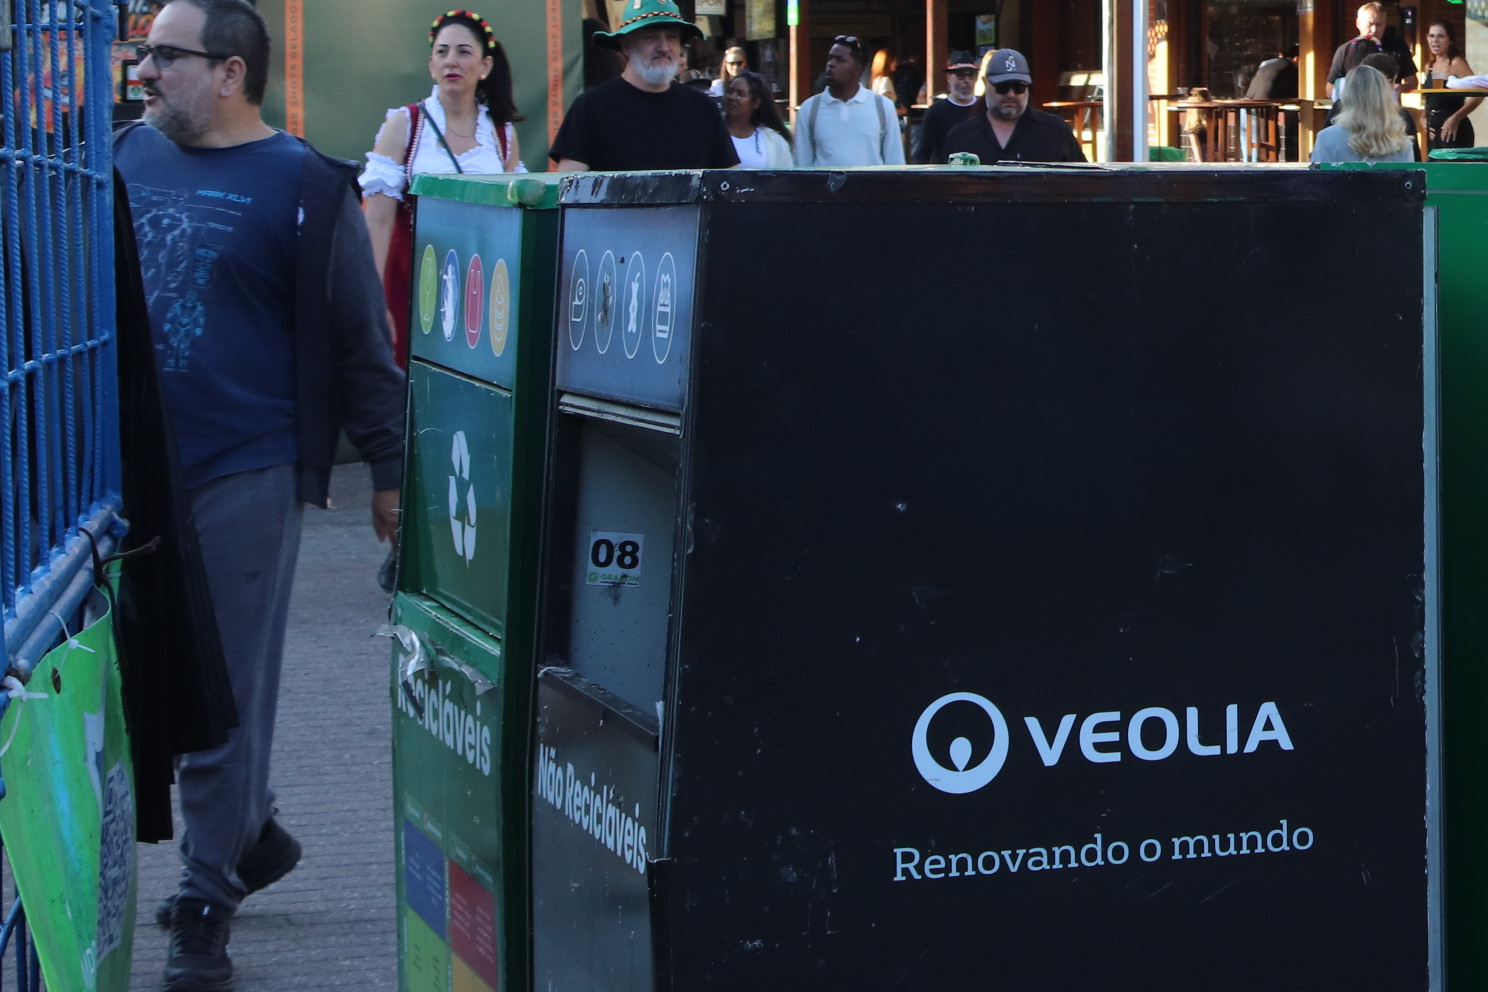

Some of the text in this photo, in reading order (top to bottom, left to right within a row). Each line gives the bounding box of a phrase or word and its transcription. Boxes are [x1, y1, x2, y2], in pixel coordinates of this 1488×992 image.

[591, 538, 640, 570] 08
[397, 654, 491, 777] Rcicláveis
[1023, 701, 1295, 767] VEOLIA
[537, 743, 563, 809] Não
[564, 762, 646, 875] Recicláveis
[893, 819, 1315, 882] Renovando o mundo
